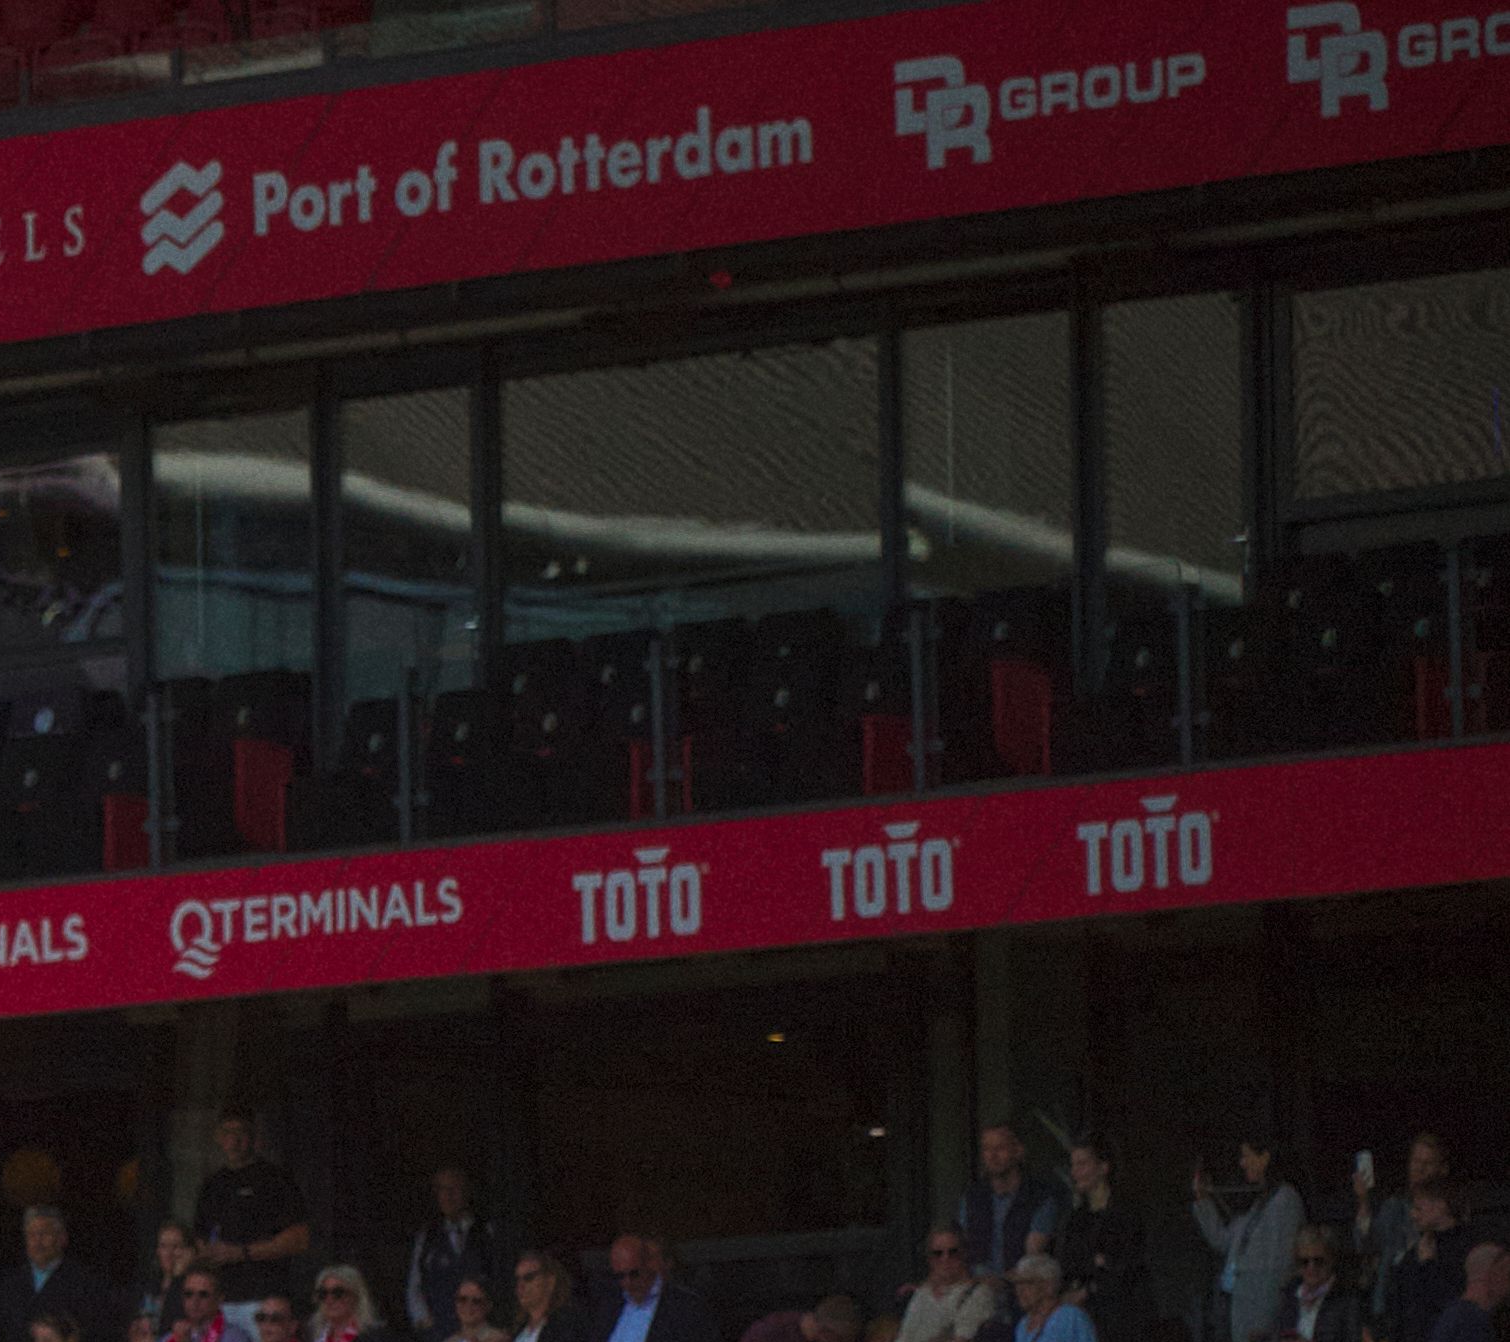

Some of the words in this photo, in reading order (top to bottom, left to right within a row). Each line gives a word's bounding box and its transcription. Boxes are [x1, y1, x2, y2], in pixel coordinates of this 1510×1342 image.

[999, 53, 1207, 120] GROUP
[252, 166, 377, 237] Port
[394, 144, 459, 217] of
[478, 106, 813, 204] Rotterdam
[820, 822, 954, 921] TOTO
[1076, 797, 1214, 896] TOTO
[169, 877, 464, 979] QTERMINALS
[571, 849, 703, 945] TOTO
